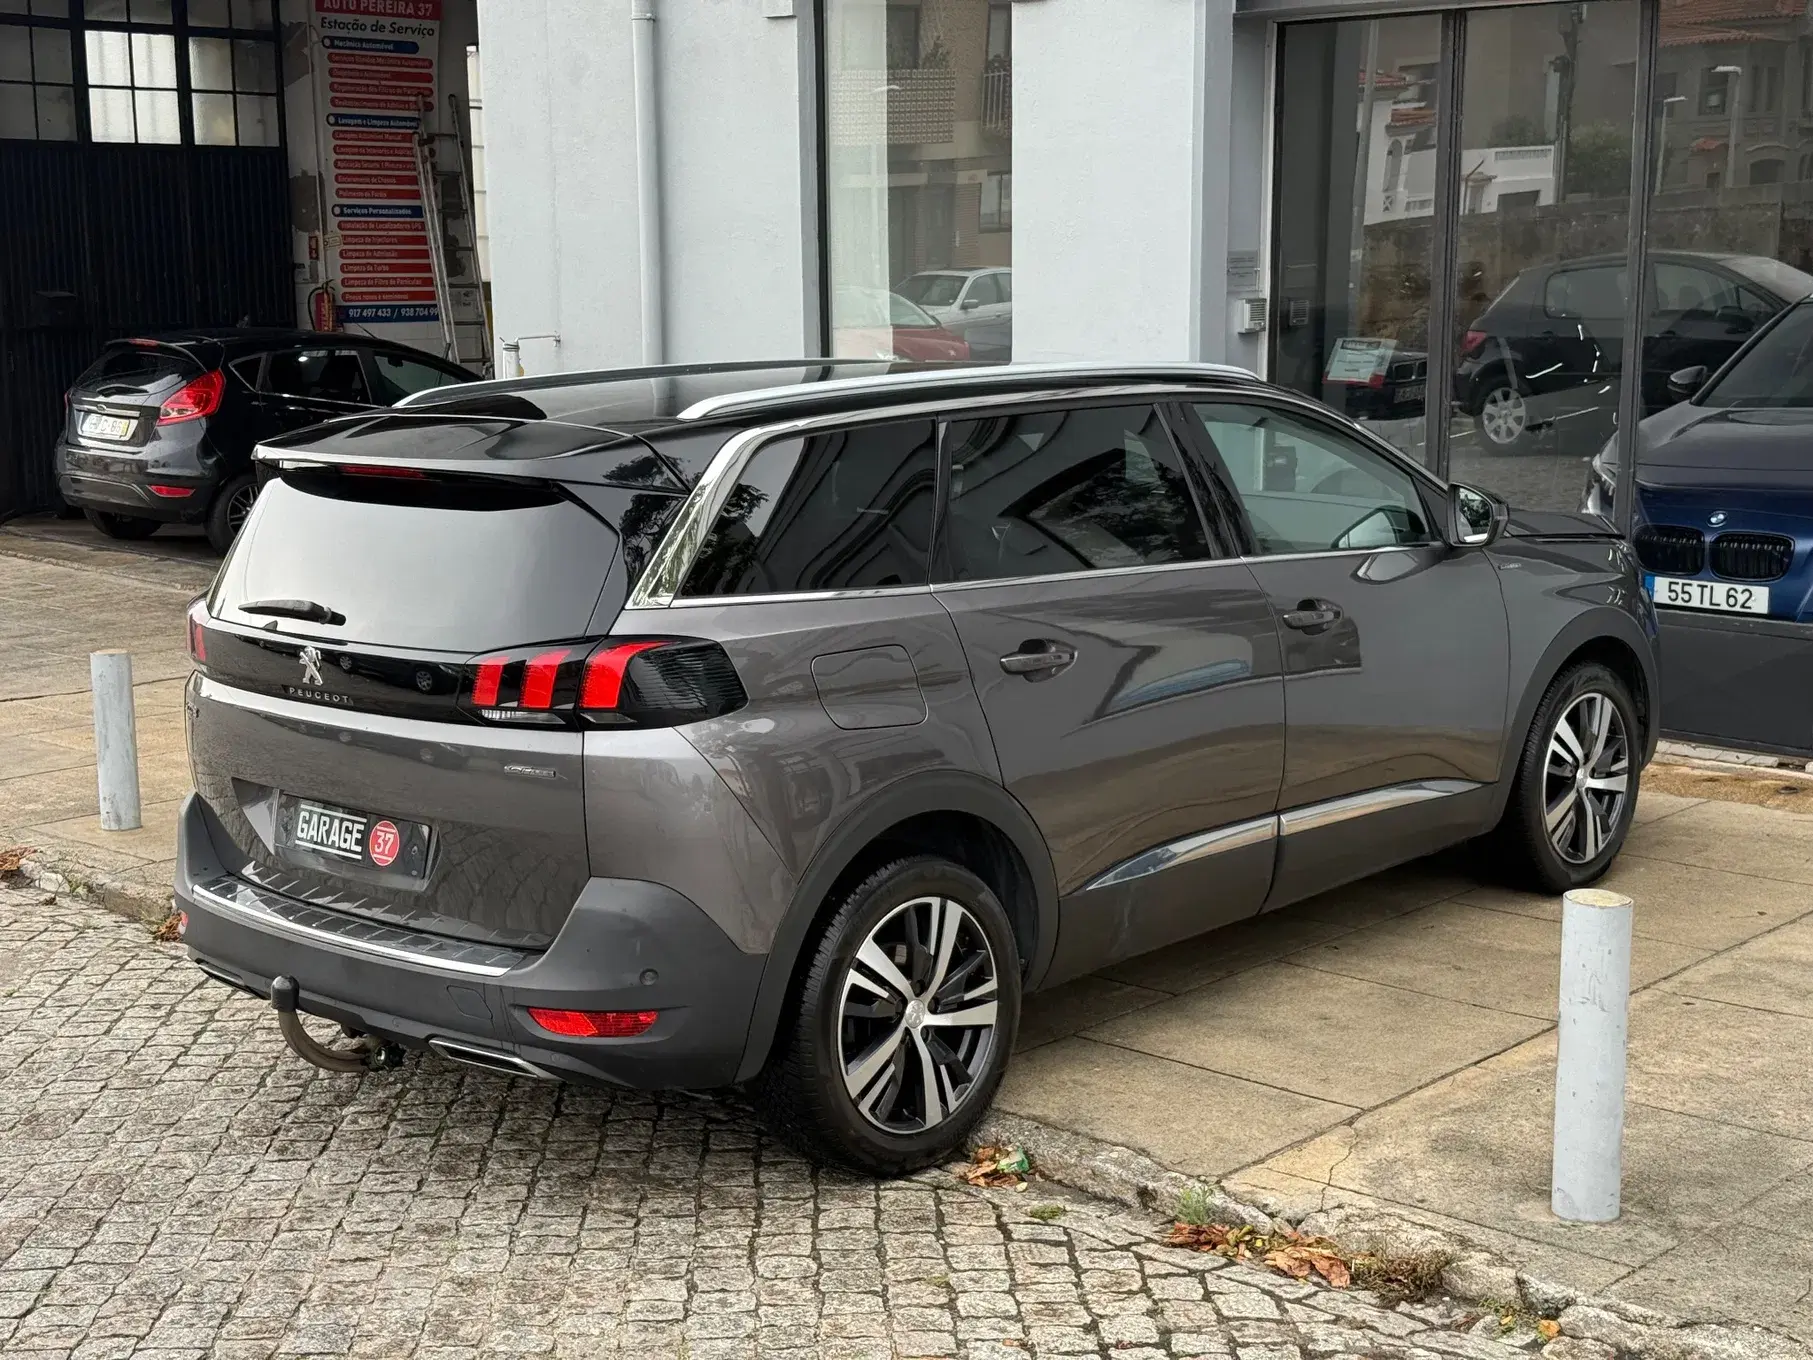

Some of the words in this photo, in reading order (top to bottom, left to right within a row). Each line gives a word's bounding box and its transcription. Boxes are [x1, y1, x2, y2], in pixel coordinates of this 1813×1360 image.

[324, 0, 356, 10] AUTO
[360, 0, 415, 16] PEREIRA
[418, 3, 433, 17] 37
[320, 16, 368, 35] Estação
[370, 19, 386, 33] de
[389, 22, 435, 39] Serviço
[343, 207, 368, 216] Serviços
[368, 208, 412, 216] Personalizados
[342, 250, 365, 259] Limpeza
[344, 264, 366, 272] Limpeza
[348, 308, 360, 318] 917
[362, 308, 376, 318] 497
[377, 308, 391, 318] 433
[400, 307, 414, 317] 938
[415, 307, 428, 316] 704
[429, 307, 438, 316] 99
[1668, 581, 1692, 604] 55
[1696, 584, 1721, 607] TL
[1726, 587, 1753, 610] 62
[289, 687, 349, 703] PEUGEOT
[297, 810, 364, 853] GARAGE
[374, 830, 395, 856] 37
